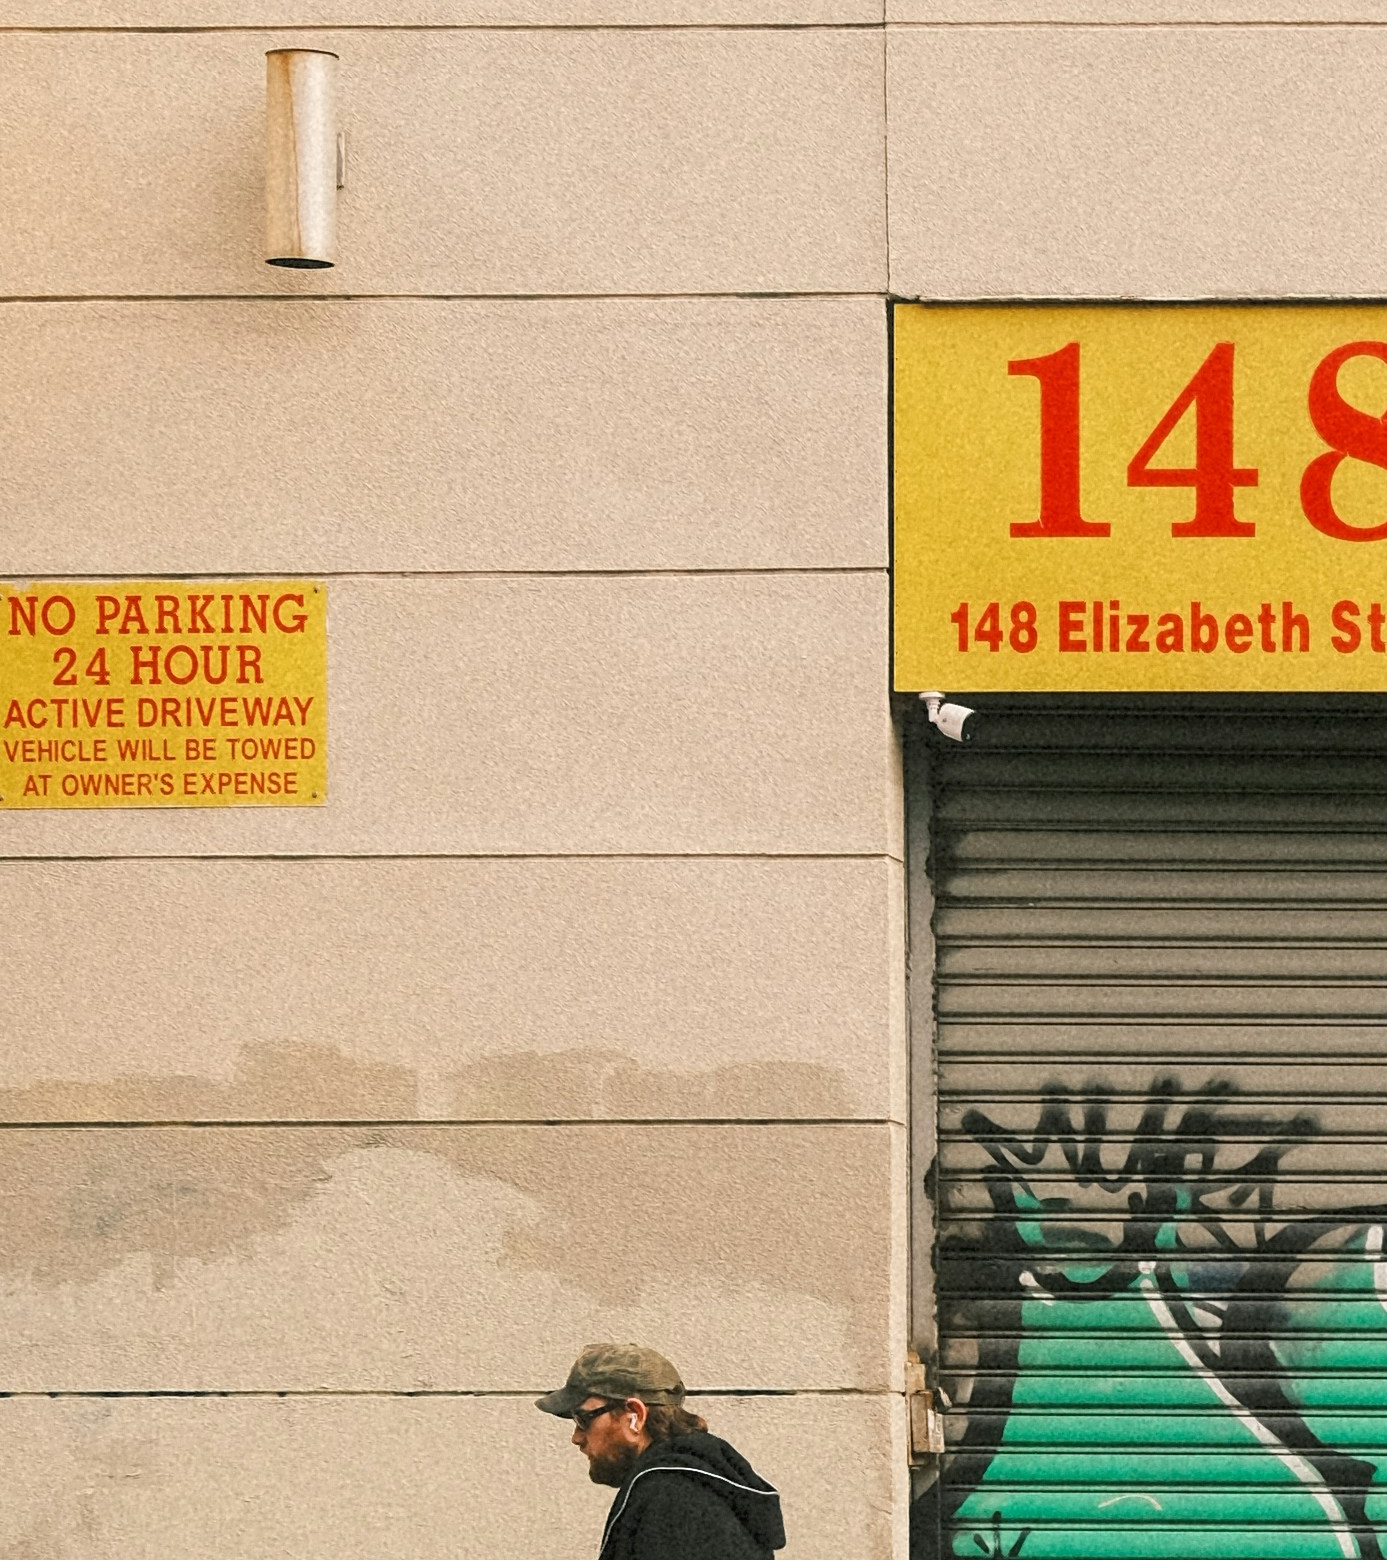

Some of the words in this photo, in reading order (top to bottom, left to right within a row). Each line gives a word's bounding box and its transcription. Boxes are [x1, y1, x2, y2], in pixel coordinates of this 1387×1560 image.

[7, 595, 77, 637] NO
[95, 593, 310, 636] PARKING
[951, 601, 1040, 655] 148
[1058, 599, 1311, 655] Elizabeth
[53, 646, 112, 687] 24
[130, 644, 265, 686] HOUR
[3, 697, 126, 730] ACTIVE
[137, 696, 315, 729] DRIVEWAY
[4, 739, 108, 763] VEHICLE
[117, 739, 177, 762] WILL
[185, 738, 218, 762] BE
[227, 737, 317, 761] TOWED
[23, 774, 53, 798] AT
[61, 772, 175, 797] OWNER'S
[183, 772, 298, 796] EXPENSE
